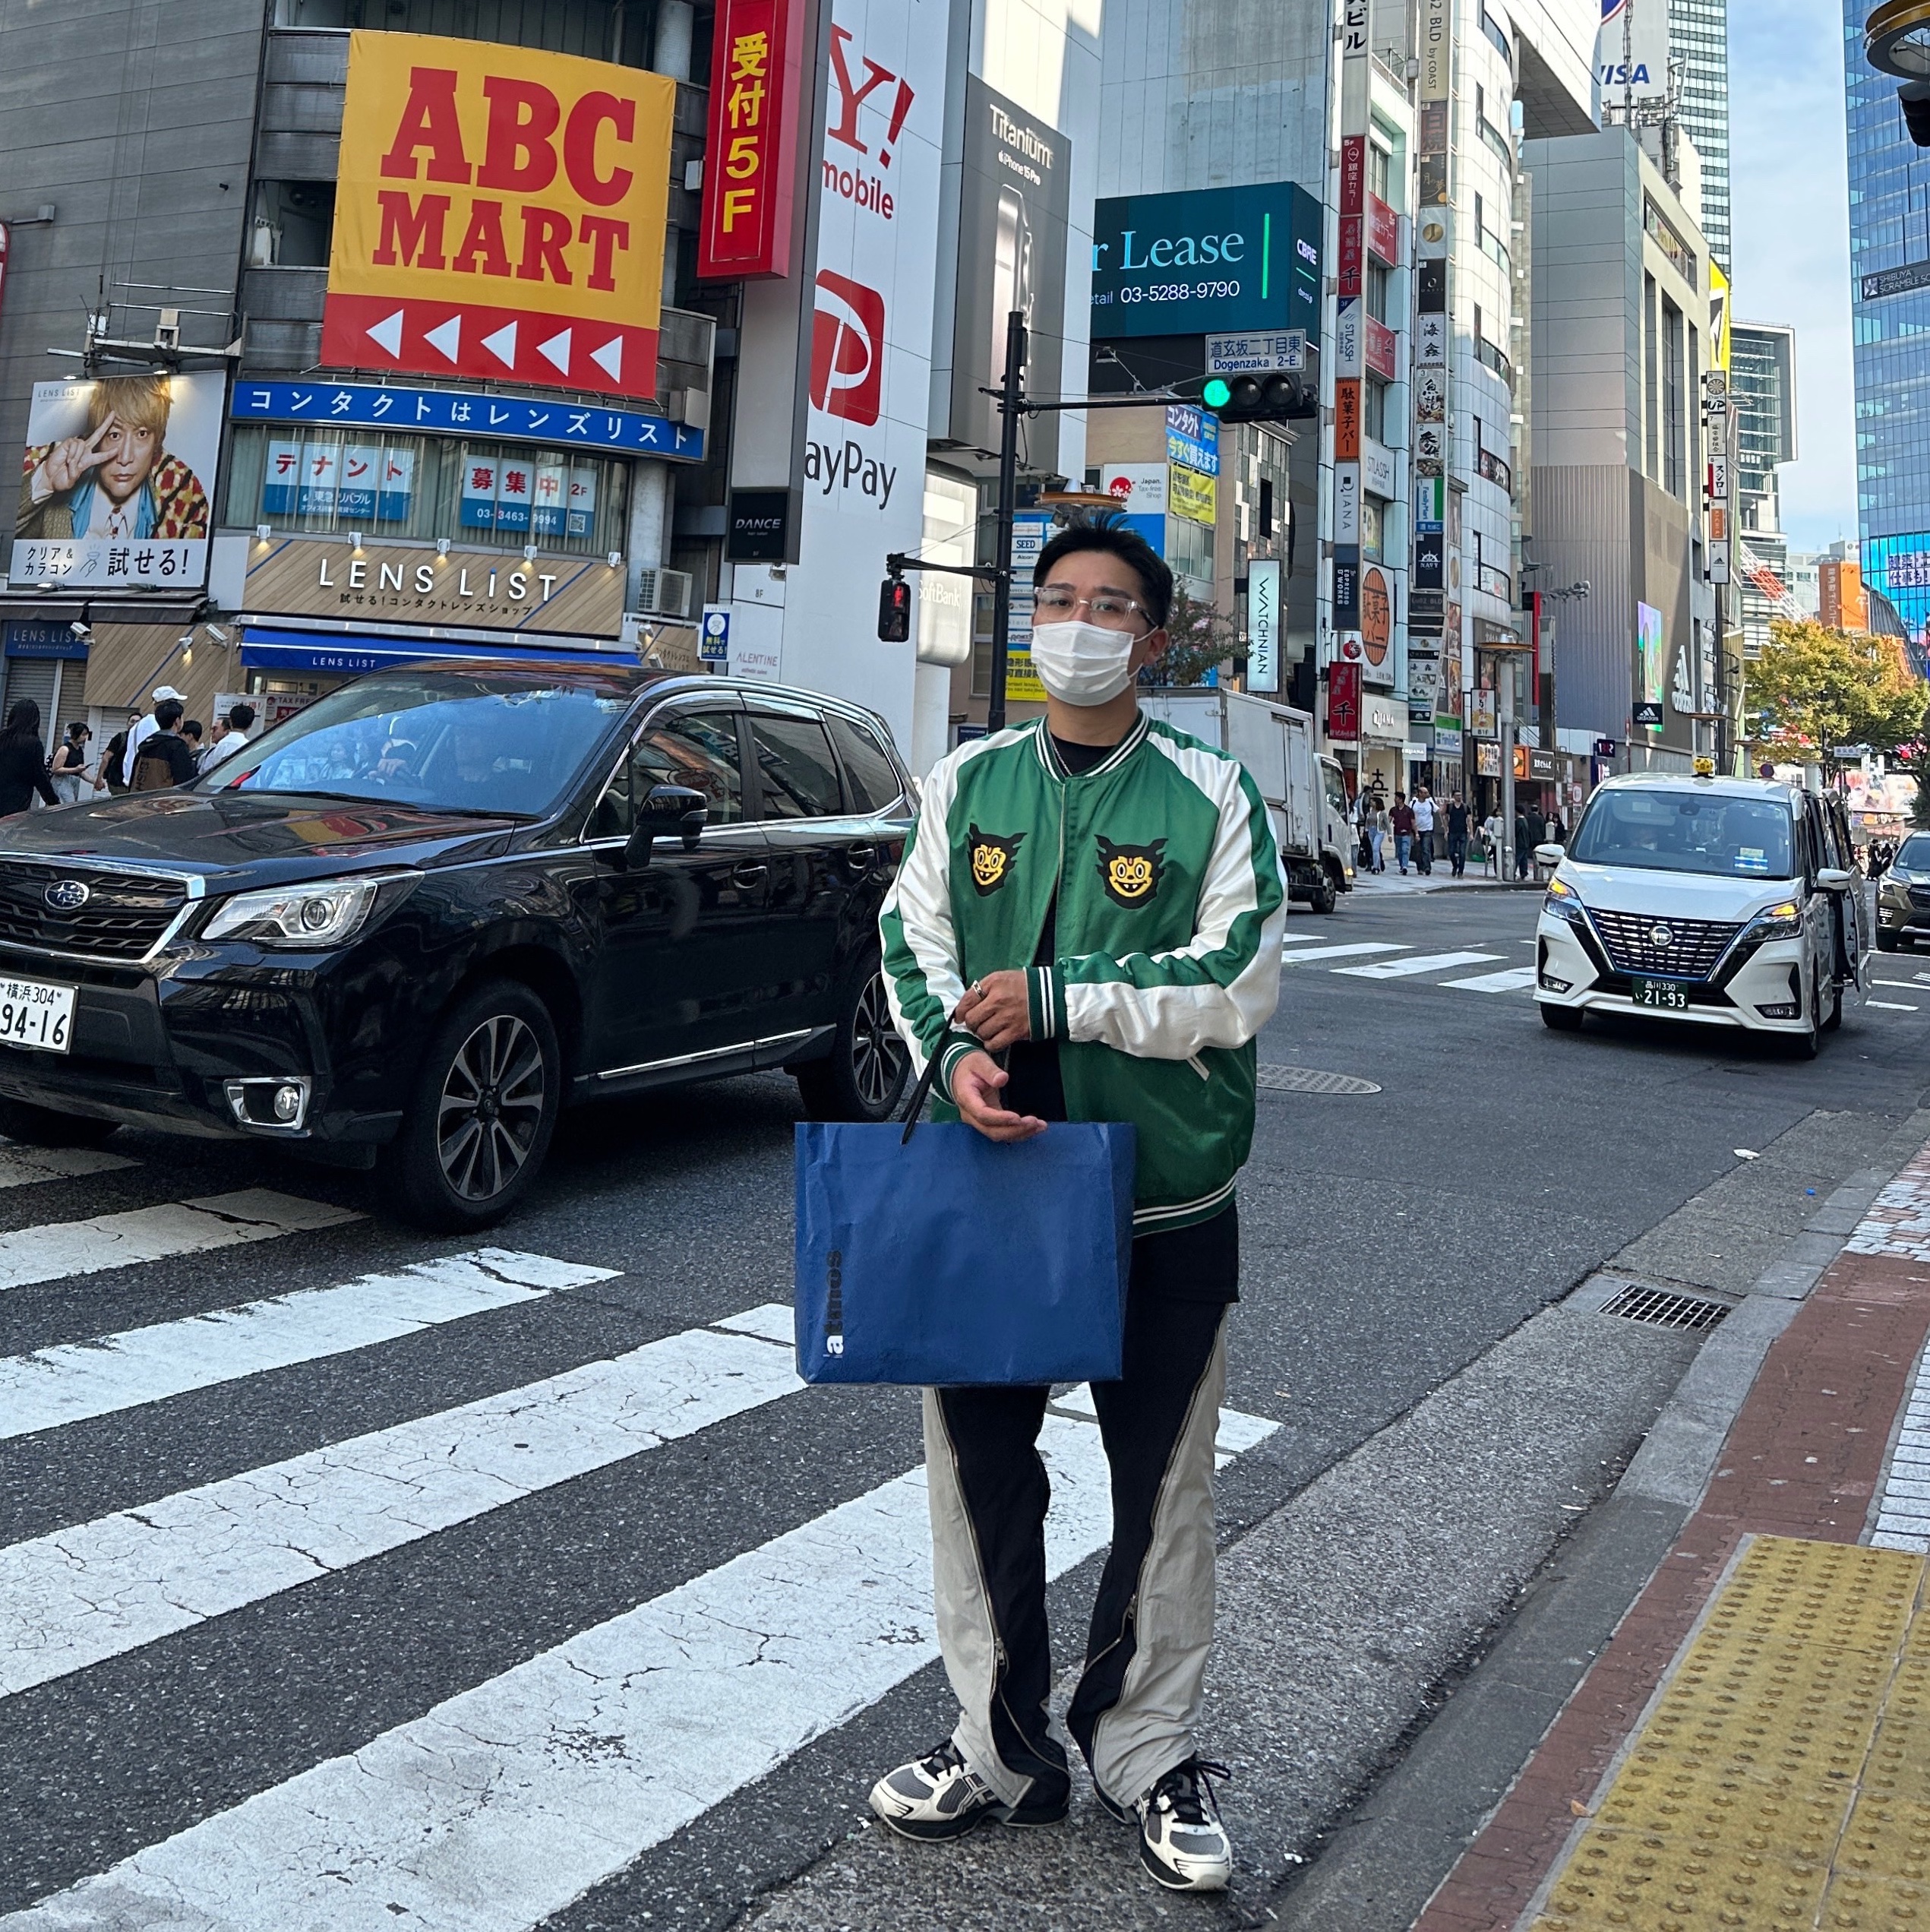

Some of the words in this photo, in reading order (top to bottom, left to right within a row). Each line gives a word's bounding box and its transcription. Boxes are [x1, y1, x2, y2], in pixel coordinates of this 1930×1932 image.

[1429, 17, 1442, 42] BLD
[1427, 47, 1438, 58] by
[1428, 61, 1436, 90] COAST
[380, 66, 636, 207] ABC
[722, 31, 768, 232] 受付5F
[990, 103, 1053, 169] Titanium
[1003, 152, 1024, 175] iPhone
[1023, 164, 1031, 179] 15
[1030, 169, 1041, 185] Pro
[822, 160, 894, 220] mobile
[1347, 163, 1358, 206] 銀座カラー
[372, 190, 630, 292] MART
[1120, 230, 1245, 270] Lease
[1297, 239, 1317, 265] CBRE
[1340, 265, 1360, 290] 千
[1879, 269, 1912, 284] SHIBUYA
[1879, 277, 1919, 293] SCRAMBLE
[1120, 280, 1240, 304] 03-5288-9790
[1210, 336, 1302, 359] 道玄坂二丁目東
[1344, 324, 1354, 362] STLASSH
[1214, 353, 1269, 372] Dogenzaka
[38, 389, 58, 397] LENS
[1708, 400, 1726, 411] UP
[251, 390, 687, 450] コンタクトはレンズリスト
[1167, 406, 1199, 438] コンタクト
[1341, 387, 1356, 453] 駄菓子バー
[276, 454, 403, 481] テナント
[1169, 437, 1218, 473] 今すぐ買えます
[472, 467, 558, 497] 募集中
[570, 483, 588, 496] 2F
[804, 440, 897, 510] ayPay
[1715, 464, 1724, 495] スシロー
[1146, 492, 1161, 500] Shop
[1421, 486, 1429, 520] FamilyMart
[735, 518, 782, 530] DANCE
[27, 546, 61, 561] クリア
[66, 548, 73, 559] &
[1016, 539, 1035, 549] SEED
[24, 562, 73, 576] カラコン
[108, 547, 188, 576] 試せる!
[319, 558, 434, 593] LENS
[340, 593, 533, 616] 試せる!コンタクトレンズショップ
[755, 589, 763, 598] 8F
[918, 580, 961, 608] SoftBank
[14, 629, 46, 643] LENS
[51, 630, 79, 643] LIS
[1258, 577, 1268, 673] WATCHNIAN
[312, 656, 343, 666] LENS
[1331, 700, 1355, 726] 千
[1644, 989, 1685, 1008] 21-93
[0, 1004, 68, 1045] 94-16
[823, 1250, 844, 1355] atmos
